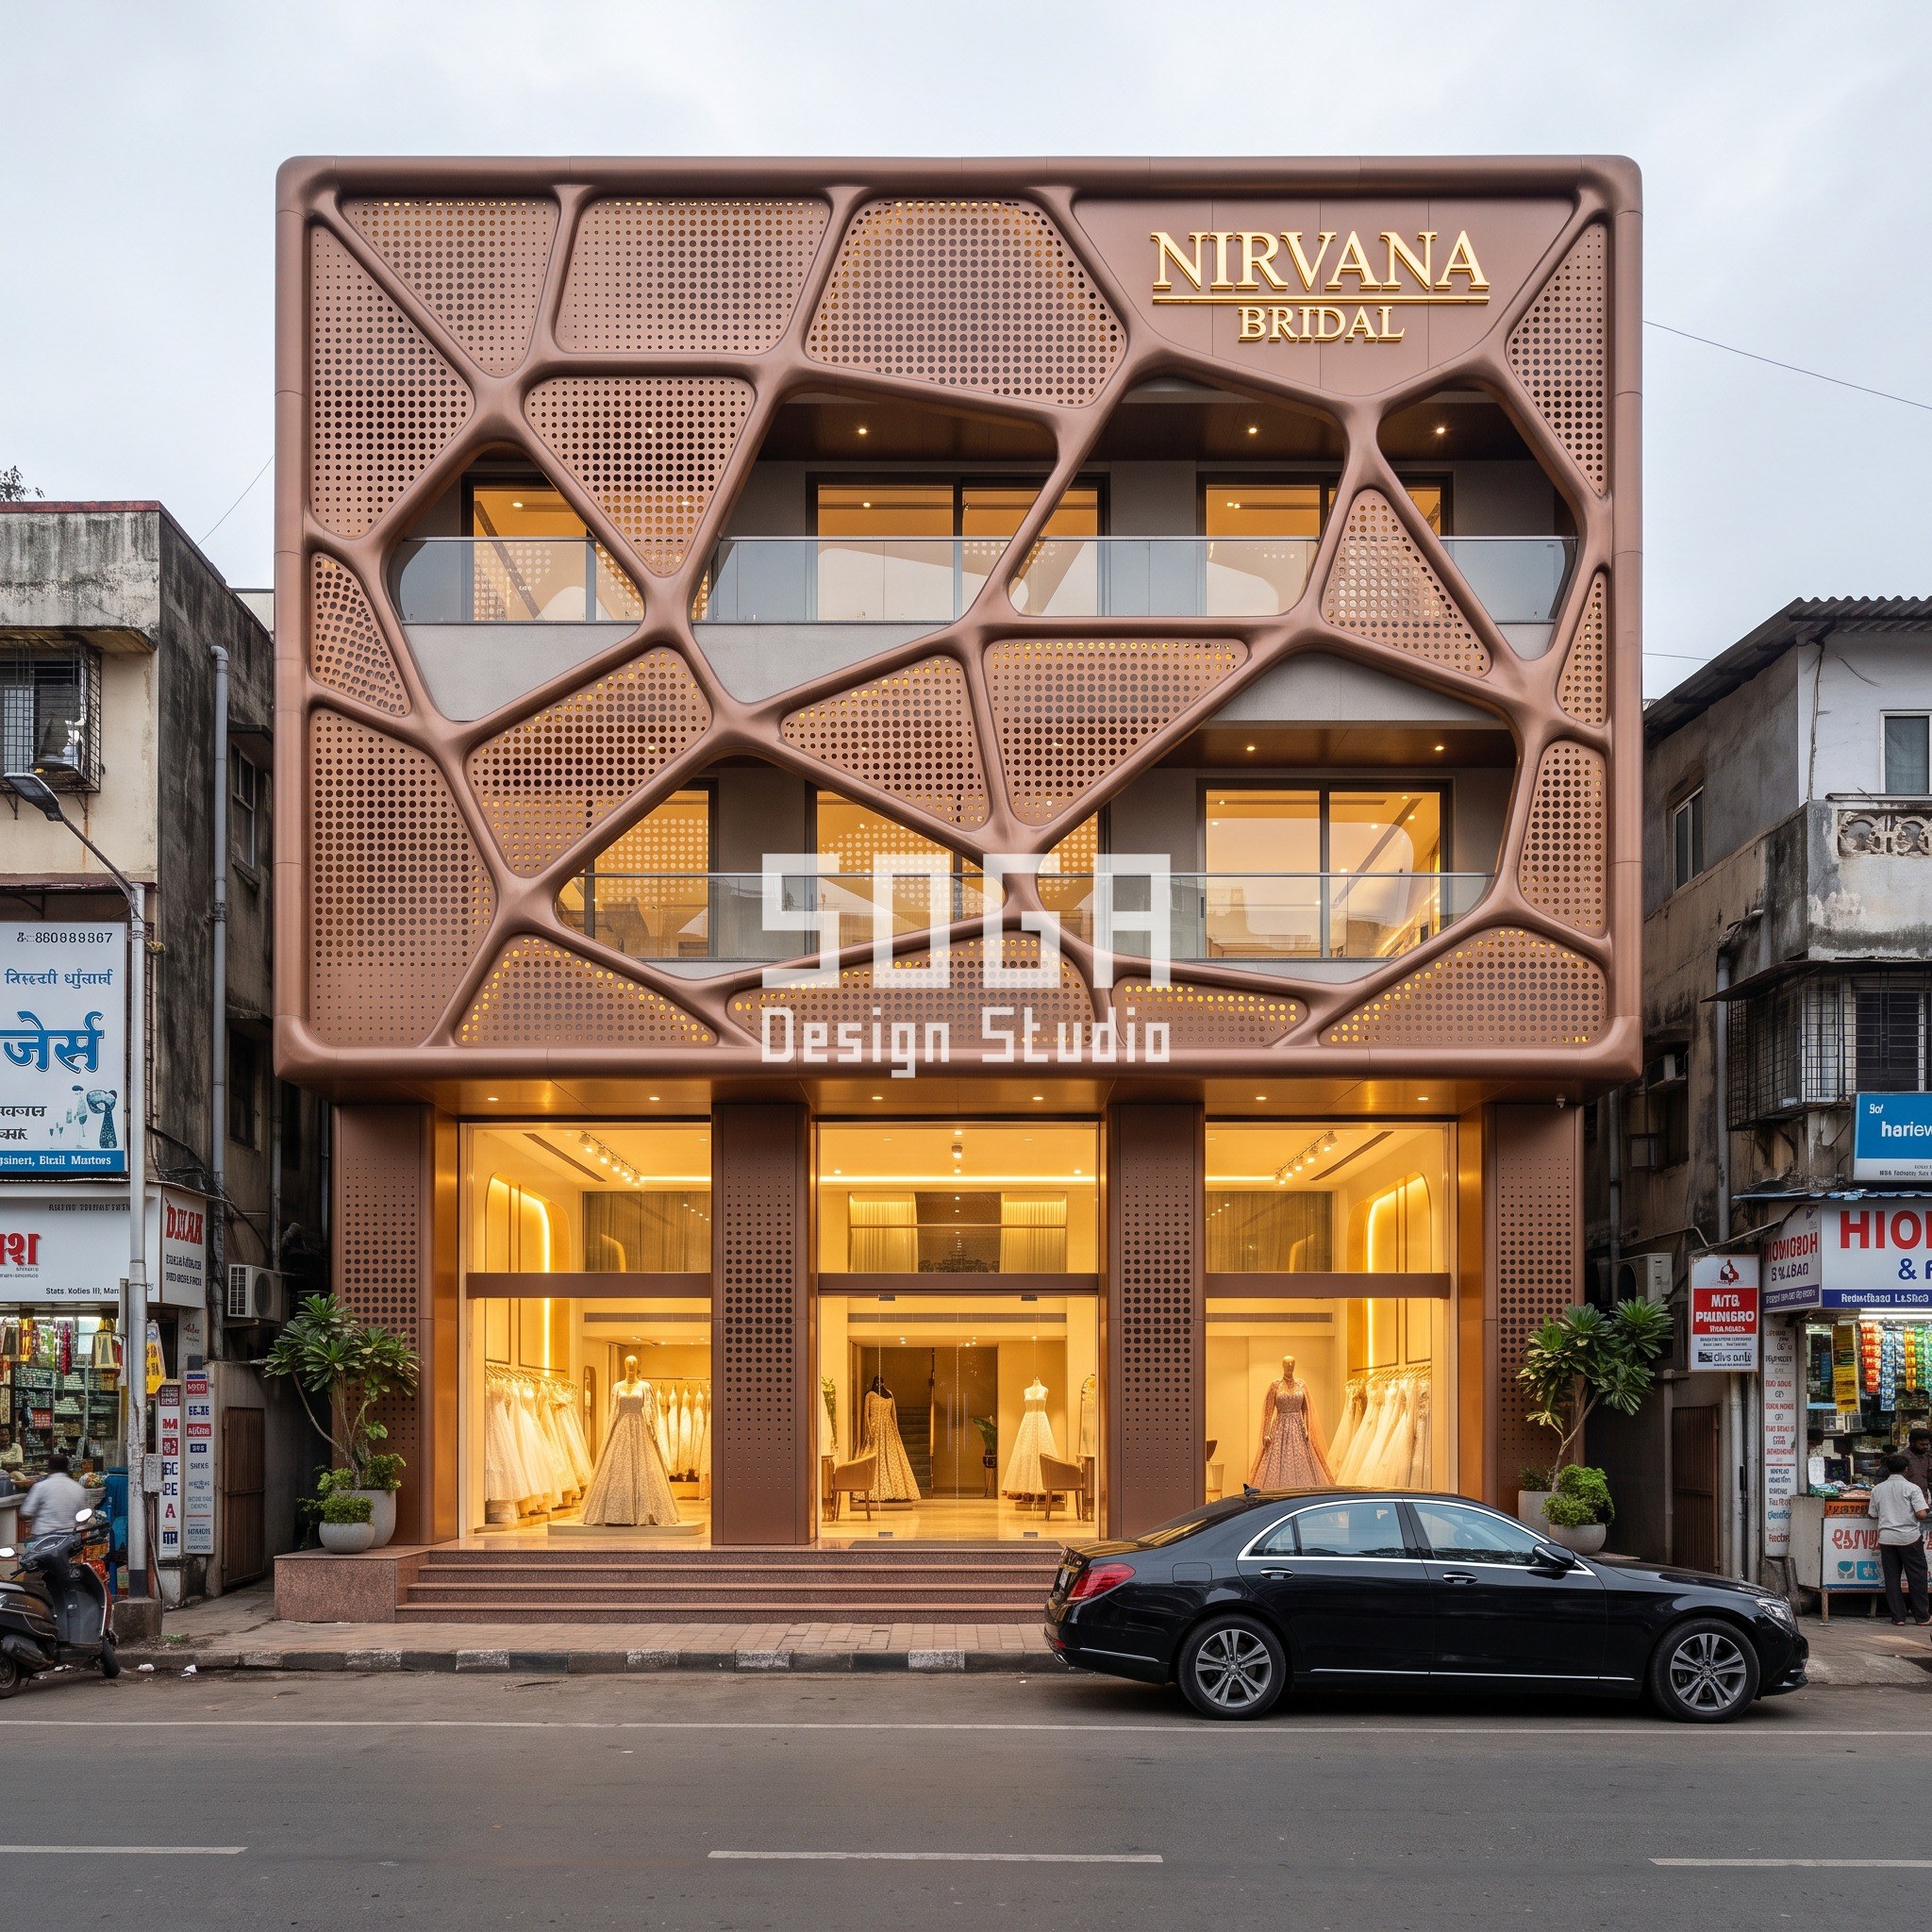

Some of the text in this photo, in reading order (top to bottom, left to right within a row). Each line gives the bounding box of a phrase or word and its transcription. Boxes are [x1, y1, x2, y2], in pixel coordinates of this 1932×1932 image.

[1150, 230, 1490, 291] NIRVANA
[1238, 306, 1406, 342] BRIDAL
[1898, 1257, 1918, 1280] &
